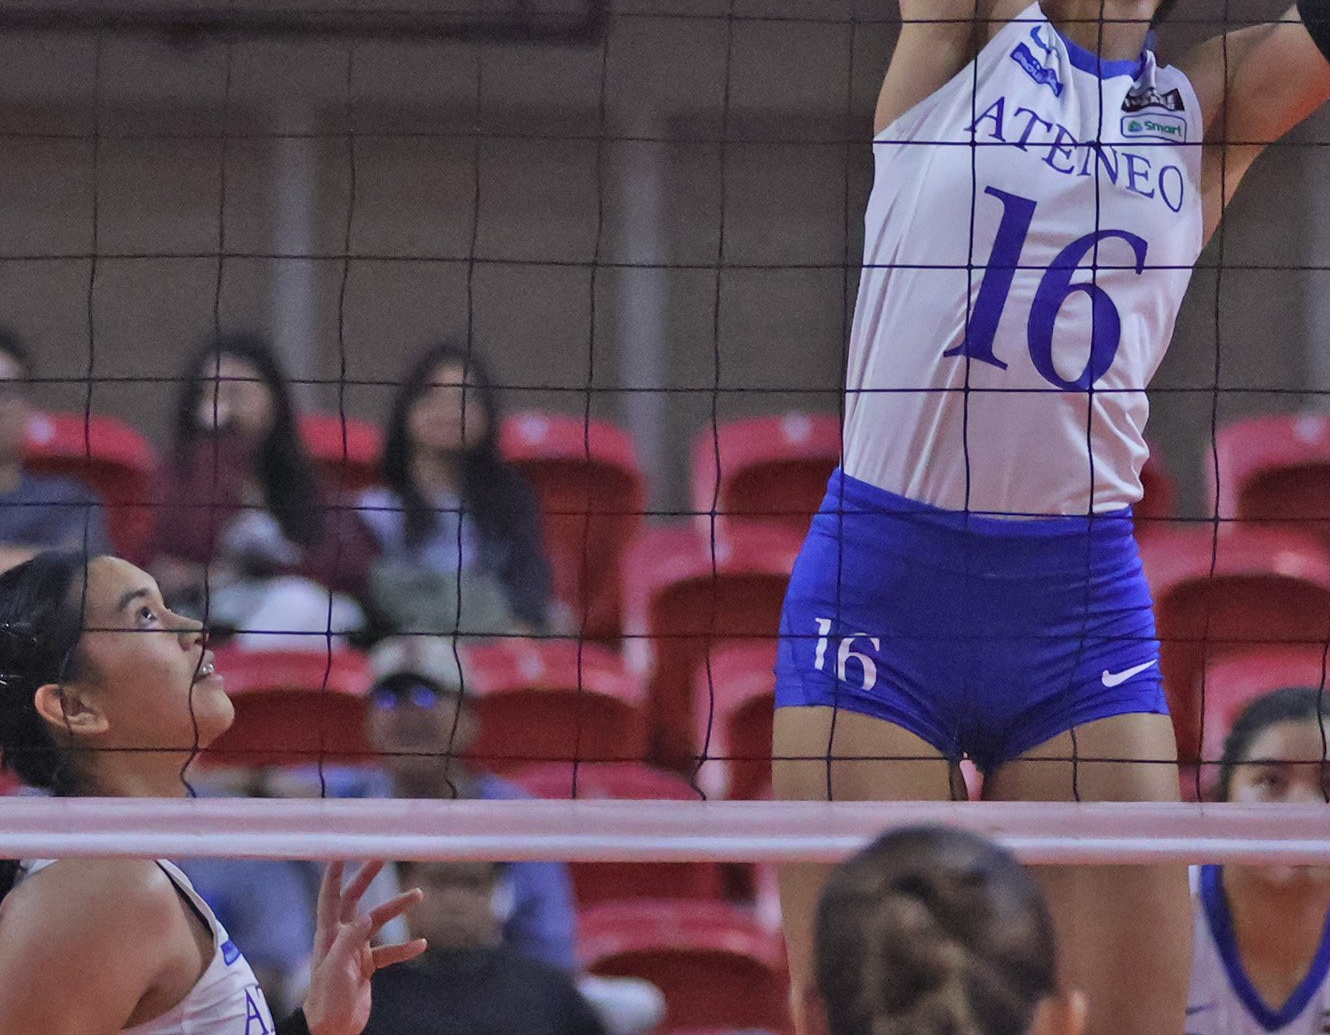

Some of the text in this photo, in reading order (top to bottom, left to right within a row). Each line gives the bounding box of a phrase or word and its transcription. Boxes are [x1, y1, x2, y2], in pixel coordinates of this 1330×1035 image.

[964, 95, 1185, 213] ATENEO
[1144, 120, 1182, 137] Smart
[943, 184, 1149, 392] 16
[814, 617, 881, 693] 16
